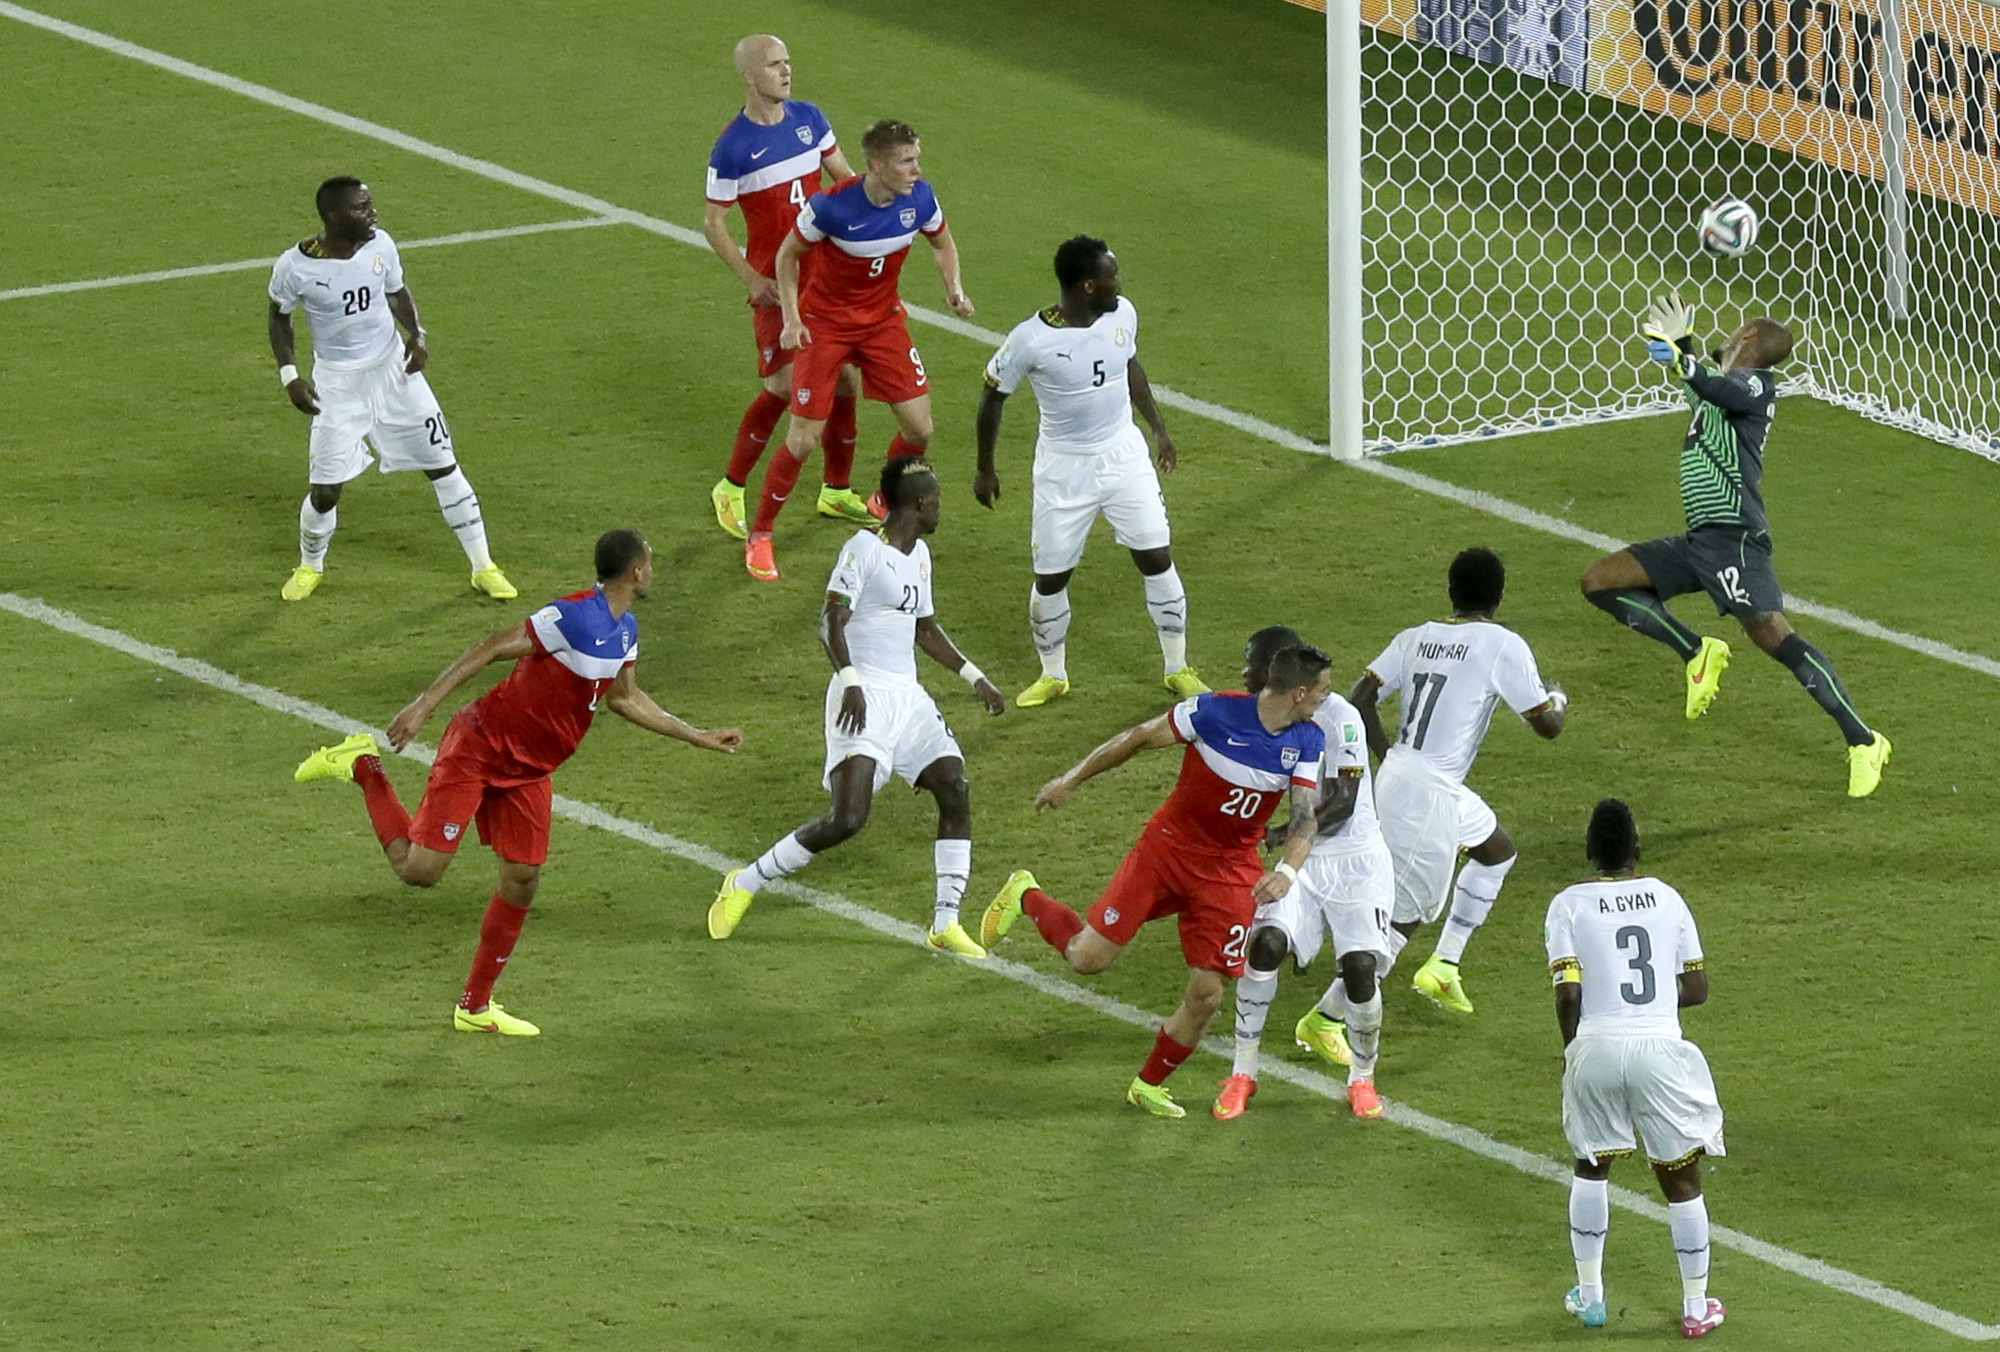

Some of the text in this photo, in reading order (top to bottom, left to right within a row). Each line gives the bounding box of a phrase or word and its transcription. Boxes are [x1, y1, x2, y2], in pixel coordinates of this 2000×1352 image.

[789, 180, 806, 209] 4
[868, 256, 886, 278] 9
[342, 286, 371, 316] 20
[908, 347, 926, 376] 9
[1092, 360, 1105, 387] 5
[1716, 565, 1746, 601] 12
[898, 584, 919, 614] 21
[1401, 672, 1448, 751] 11
[1219, 786, 1262, 819] 20
[1599, 892, 1657, 914] A.GYAN
[1615, 925, 1656, 1006] 3
